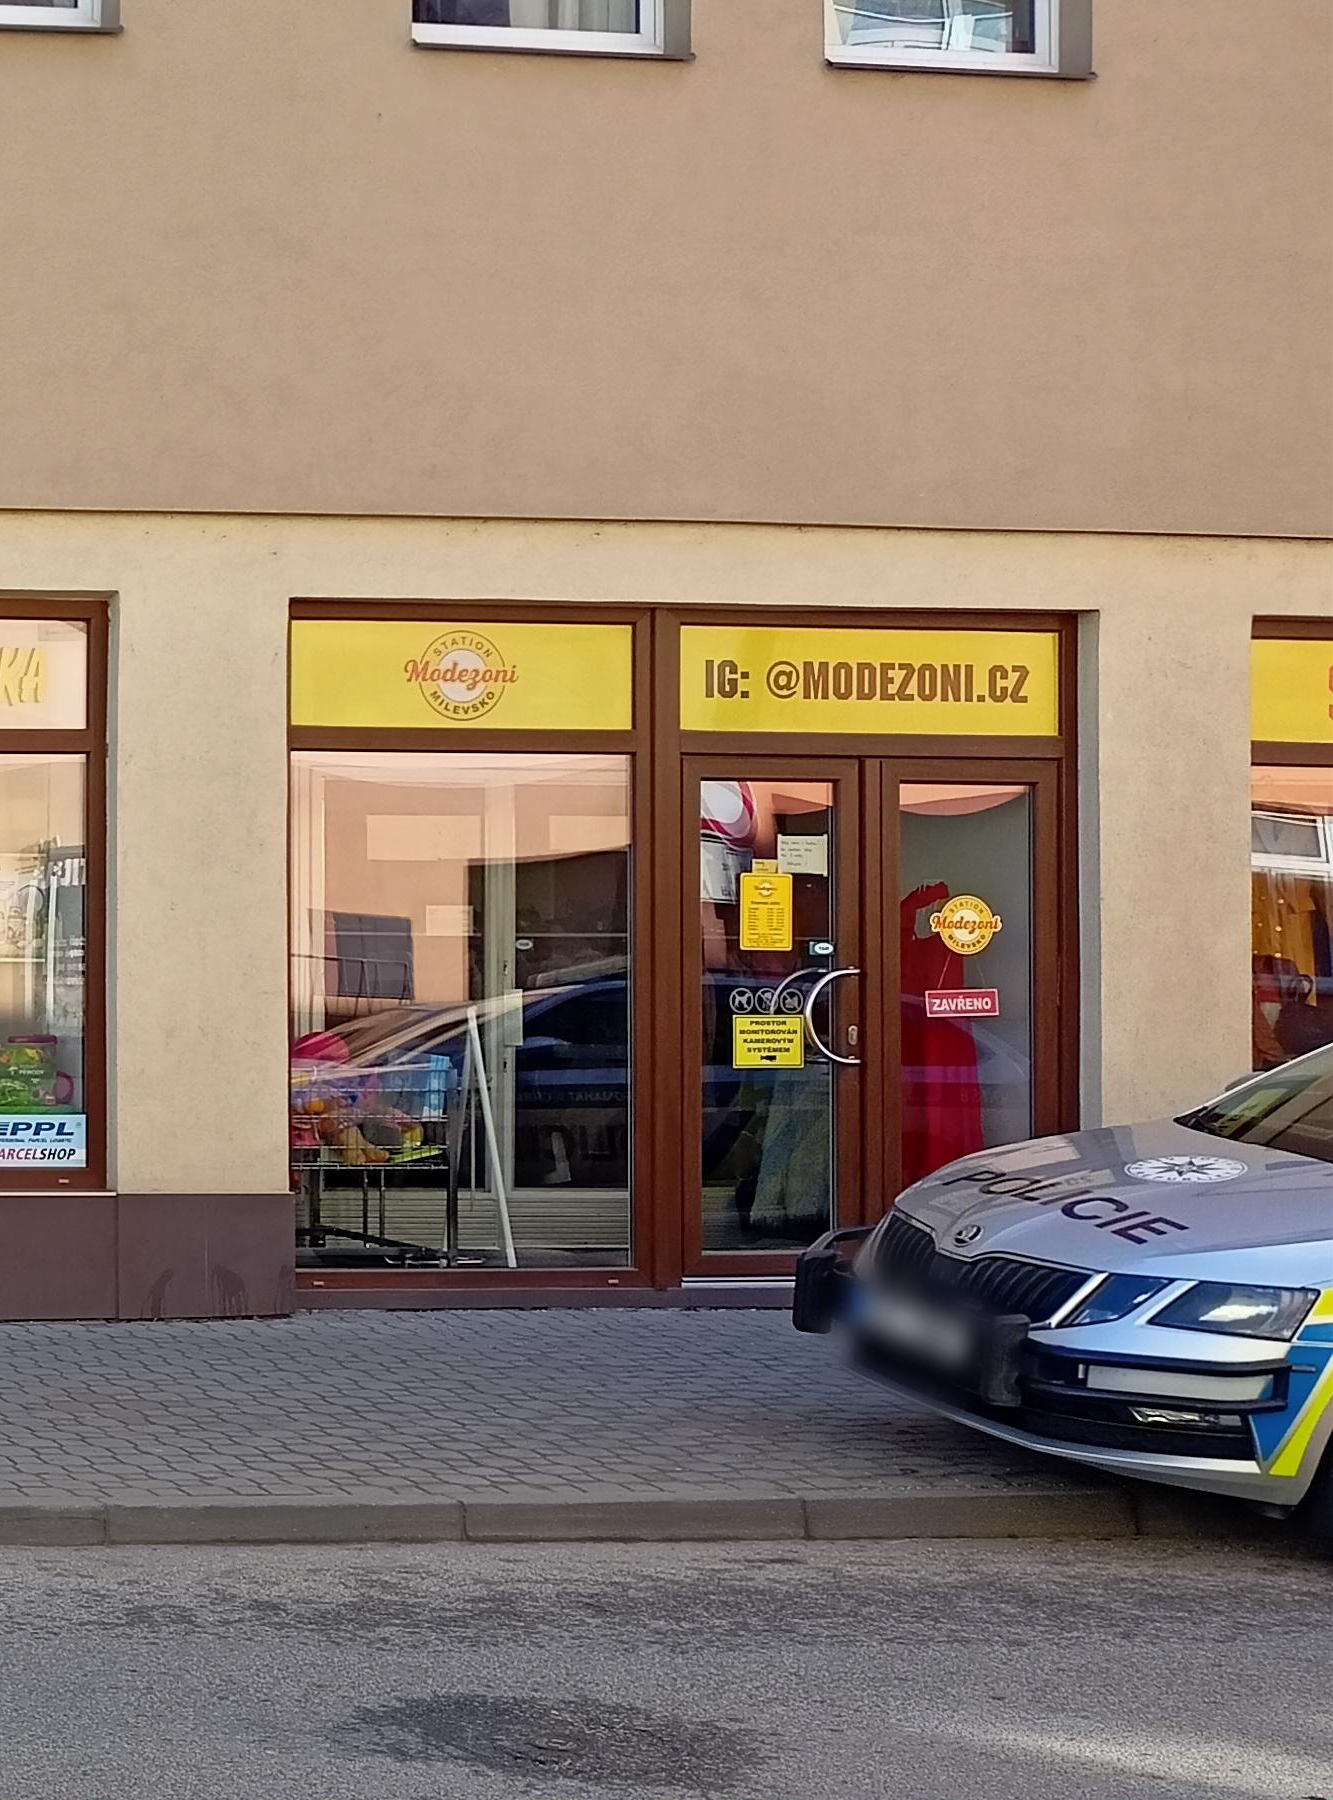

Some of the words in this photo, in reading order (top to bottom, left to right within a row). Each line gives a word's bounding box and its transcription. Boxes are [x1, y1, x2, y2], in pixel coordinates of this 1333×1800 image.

[433, 636, 493, 658] STATION
[404, 659, 520, 691] Modezoni
[705, 659, 750, 700] IG:
[766, 659, 1030, 705] @MODEZONI.CZ
[430, 691, 495, 715] MILEVSKO
[931, 915, 999, 935] Modezoni
[932, 995, 993, 1012] ZAVŘENO
[9, 1121, 75, 1137] PPL
[942, 1170, 1190, 1246] POLICIE
